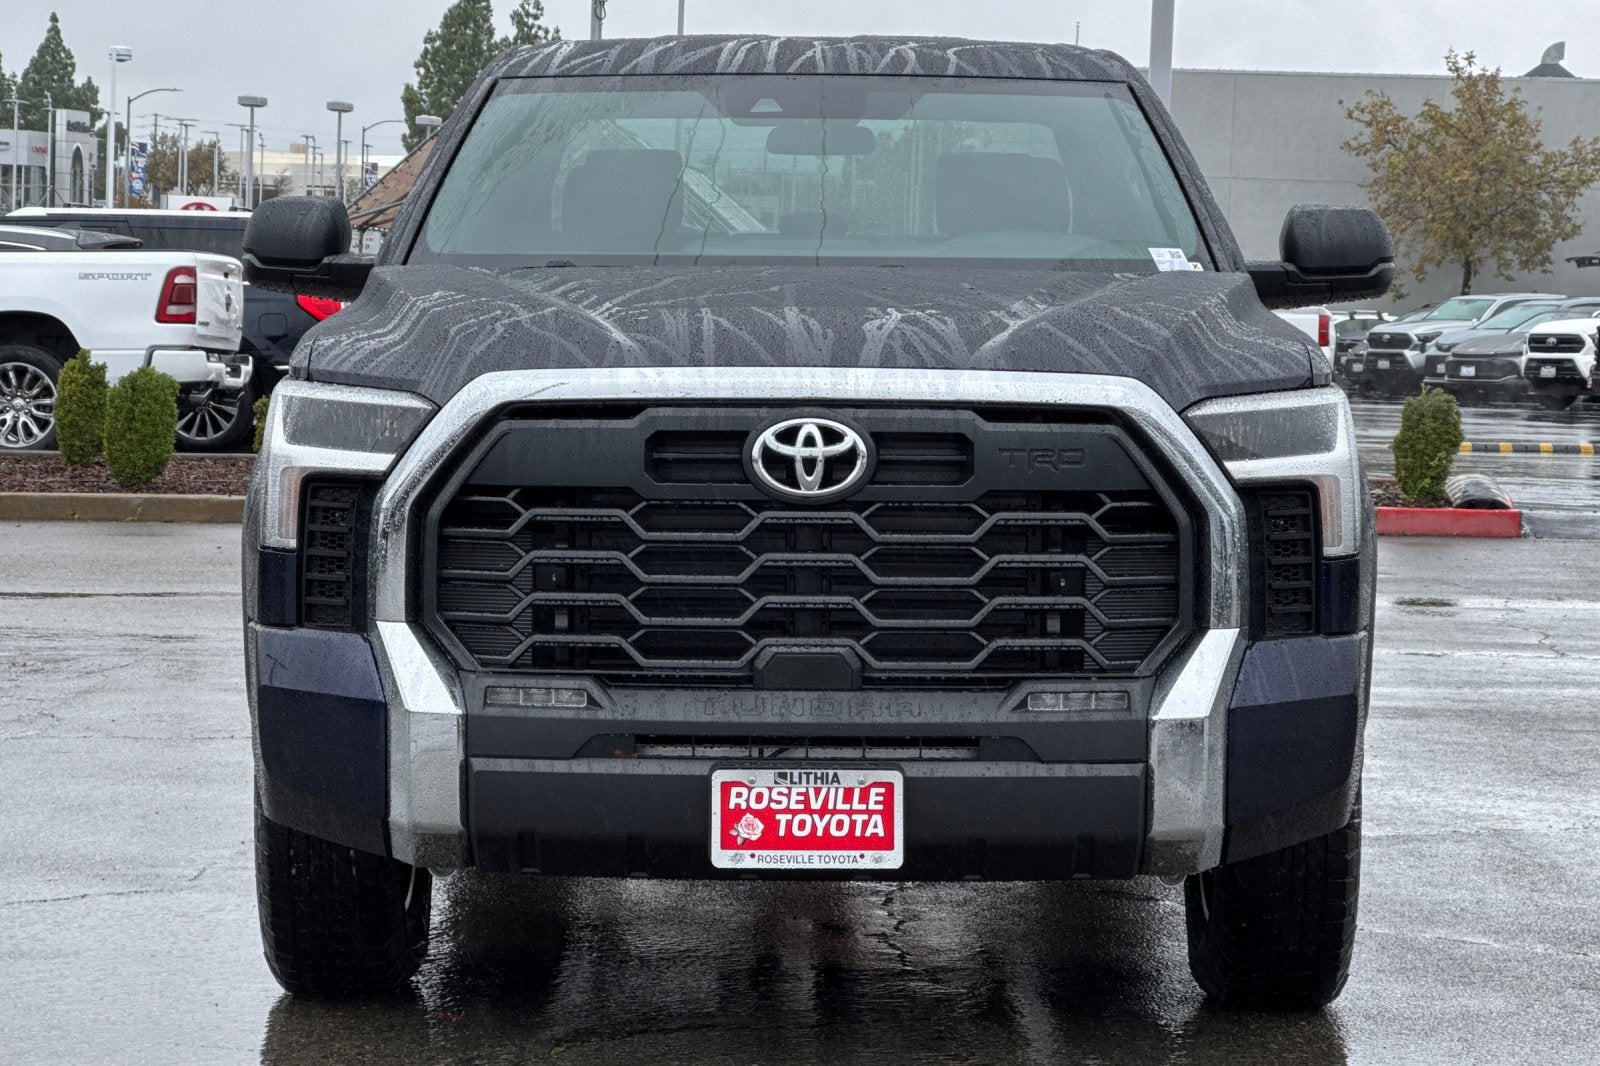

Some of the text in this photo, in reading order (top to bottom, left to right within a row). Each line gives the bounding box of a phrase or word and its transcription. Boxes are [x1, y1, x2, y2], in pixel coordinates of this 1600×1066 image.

[79, 272, 152, 281] SPORT
[998, 448, 1086, 473] TRD
[695, 696, 922, 717] TUNDRA
[789, 771, 841, 785] LITHIA
[728, 786, 886, 810] ROSEVILLE
[775, 813, 886, 837] TOYOTA
[757, 854, 859, 864] ROSEVILLE TOYOTA
